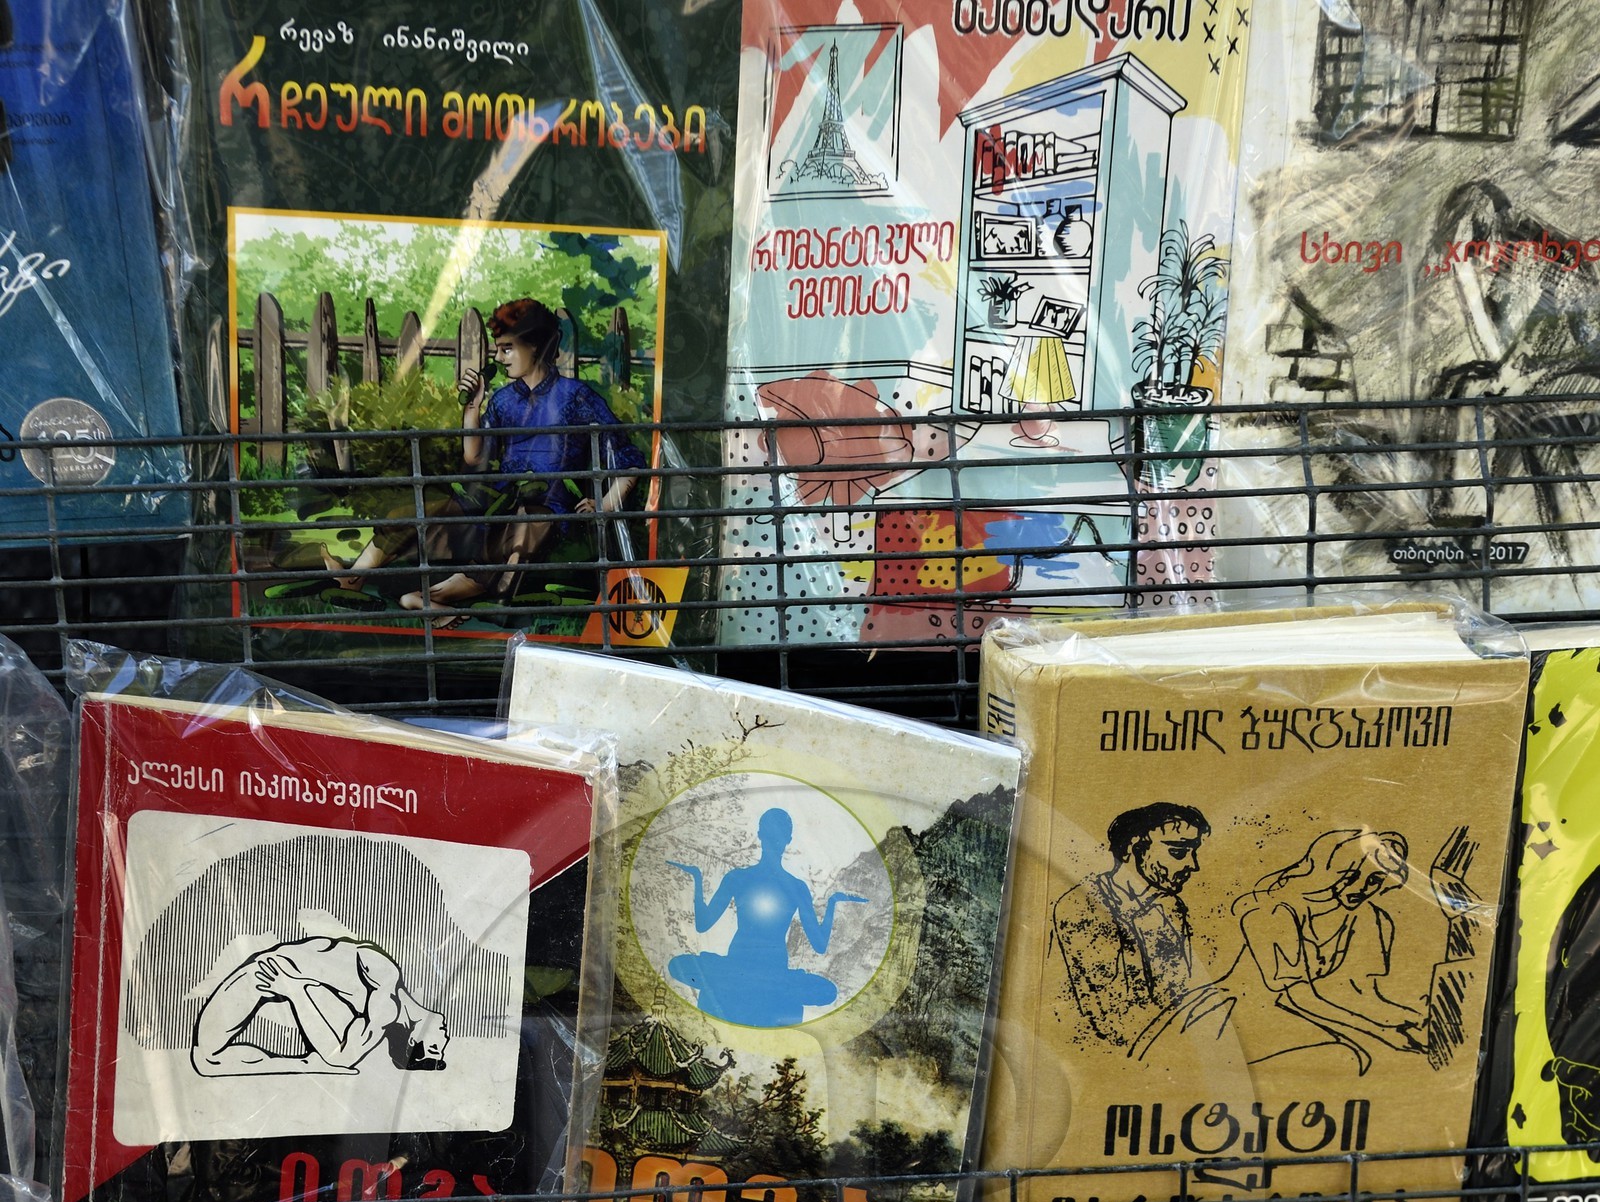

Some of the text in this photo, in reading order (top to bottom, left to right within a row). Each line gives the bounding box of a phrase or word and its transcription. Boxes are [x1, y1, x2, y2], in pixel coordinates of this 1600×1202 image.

[279, 18, 530, 65] რევაზ ინანიშვილი
[219, 34, 706, 153] რჩეული მოთხრობები
[751, 221, 955, 272] რომანტიკული
[1300, 231, 1403, 273] სხივი
[787, 272, 911, 319] ეგოისტი
[1393, 546, 1464, 564] თბილისი
[1488, 546, 1526, 561] 2017
[1100, 705, 1454, 755] მიხაილ ბულგაკოვი
[127, 759, 418, 814] ალექსი იაკობაშვილი
[1103, 1099, 1371, 1157] ოსტატი
